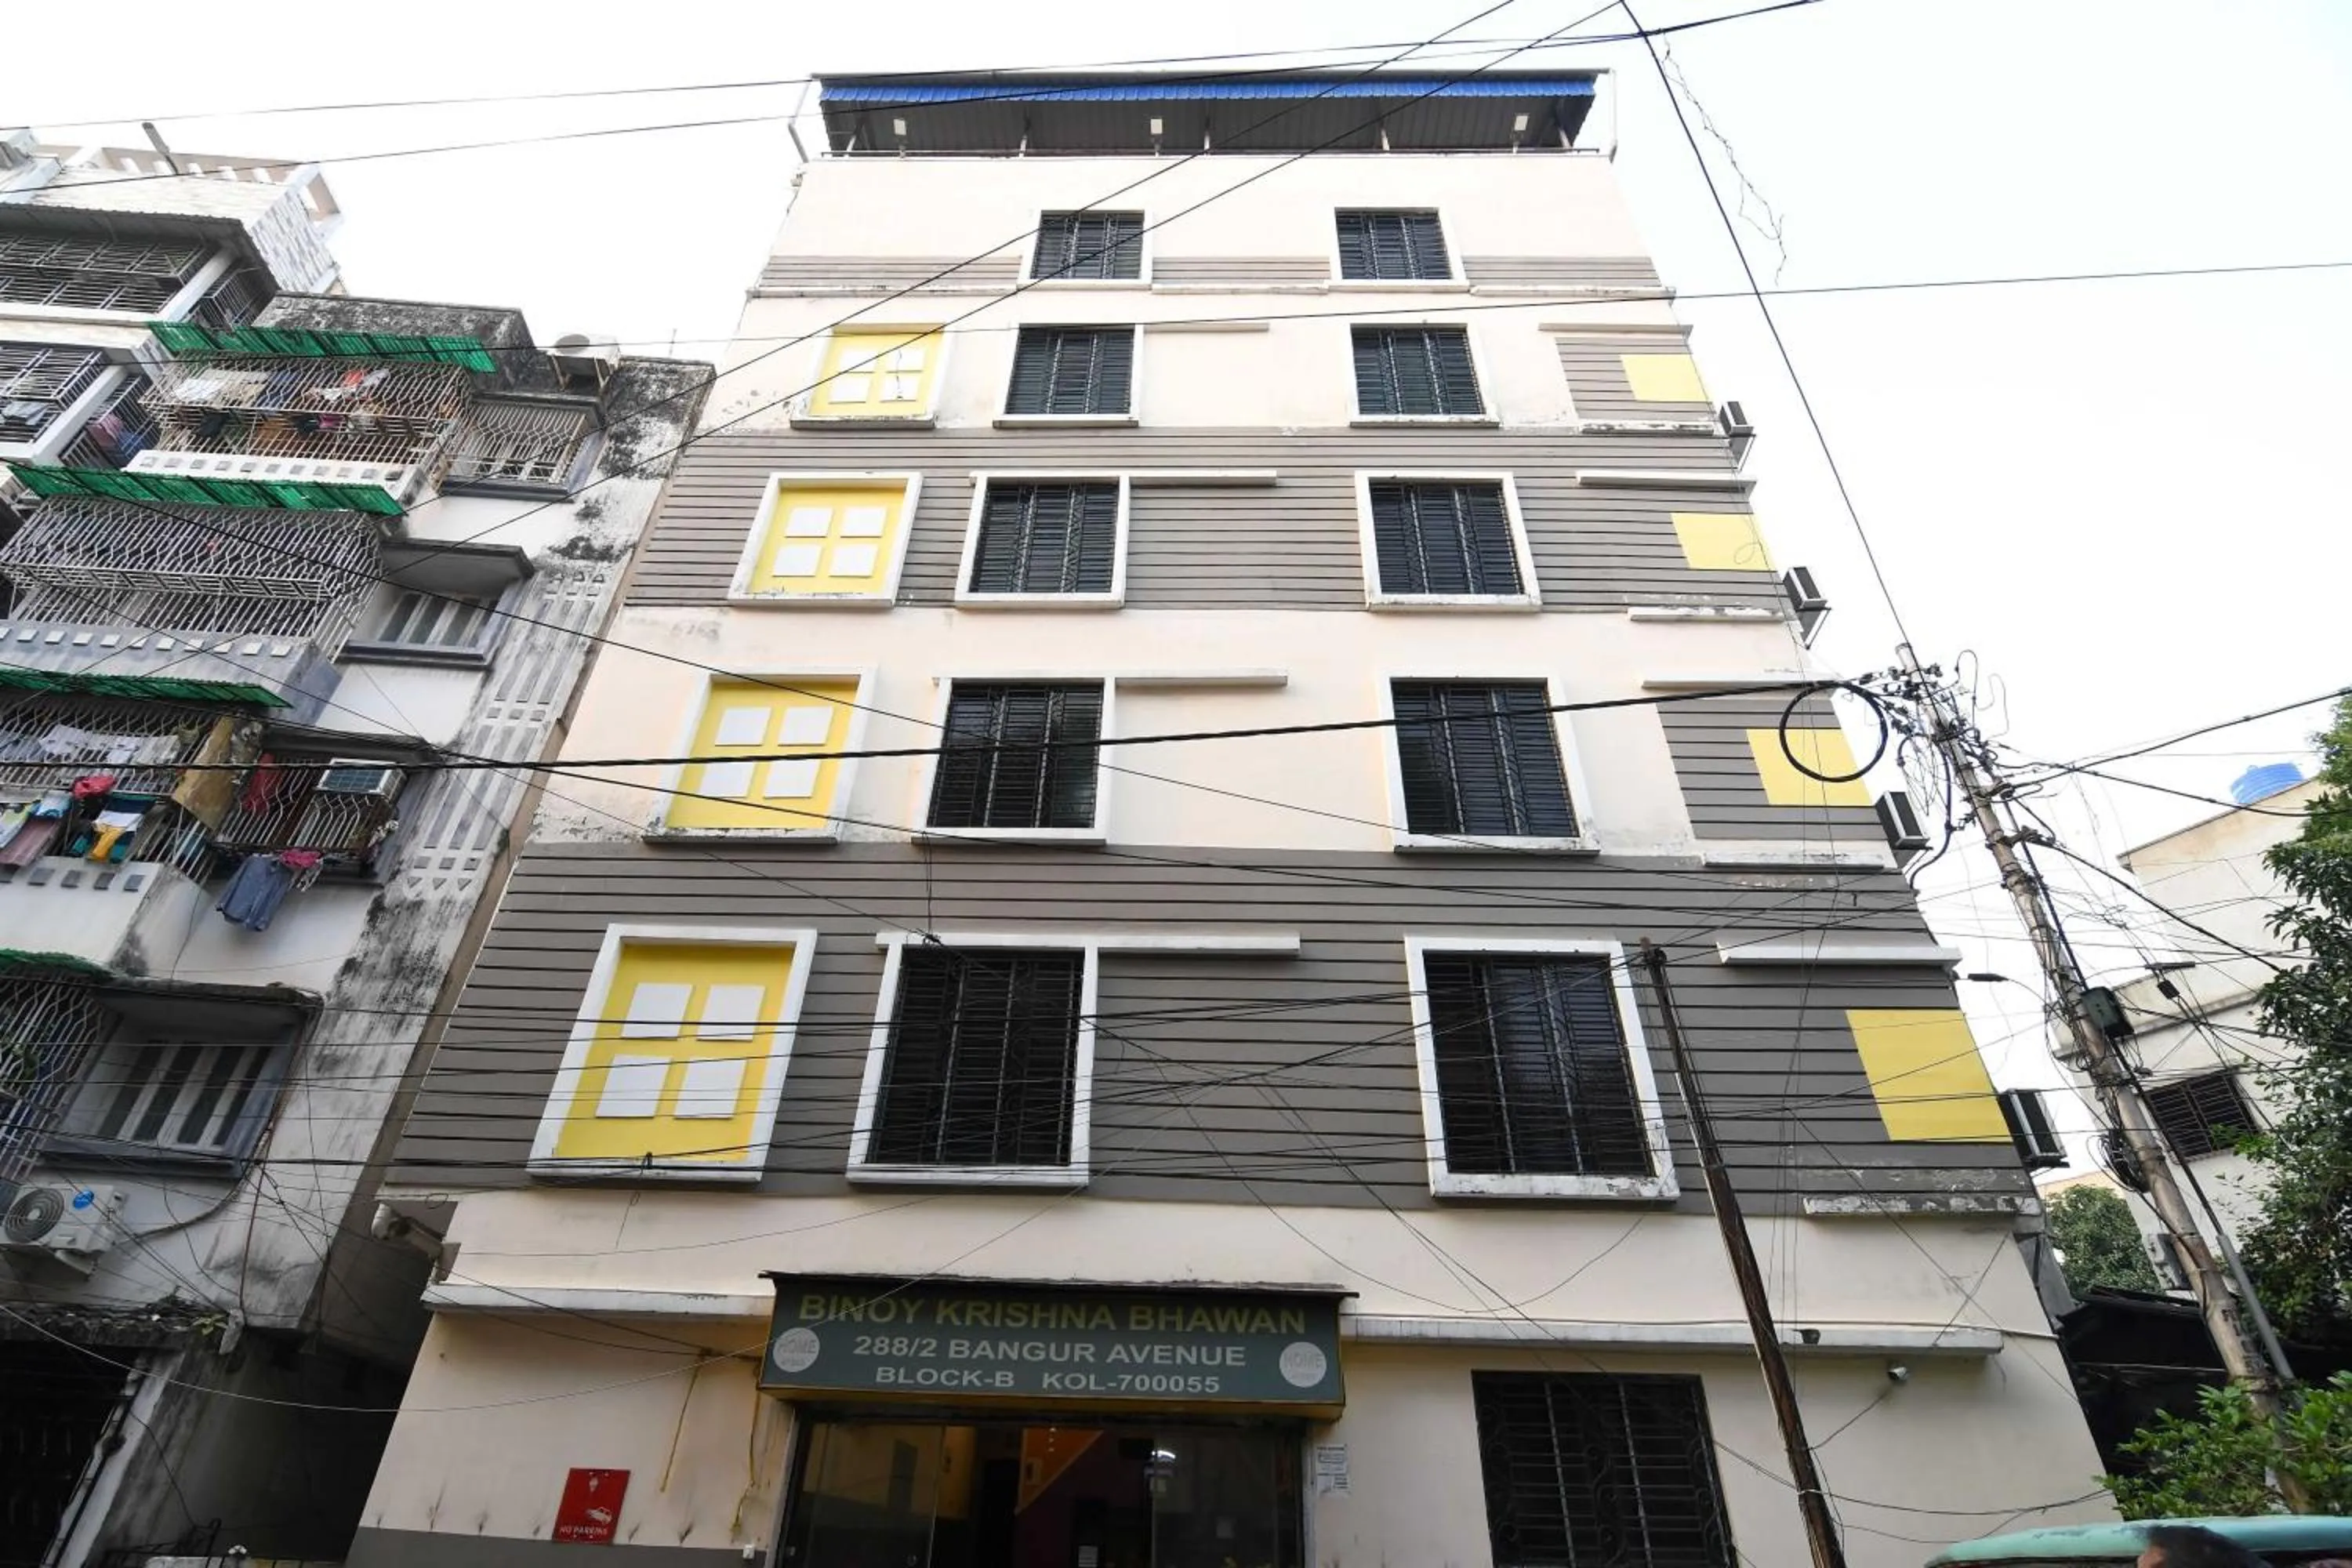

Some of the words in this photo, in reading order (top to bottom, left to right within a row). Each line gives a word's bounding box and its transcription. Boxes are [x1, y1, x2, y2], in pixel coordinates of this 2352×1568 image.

[799, 1294, 924, 1323] BINOY
[935, 1299, 1116, 1330] KRISHNA
[1129, 1305, 1305, 1334] BHAWAN
[853, 1336, 938, 1357] 288/2
[948, 1339, 1096, 1363] BANGUR
[1105, 1344, 1246, 1366] AVENUE
[876, 1367, 1014, 1388] BLOCK-B
[1042, 1372, 1220, 1393] KOL-700055
